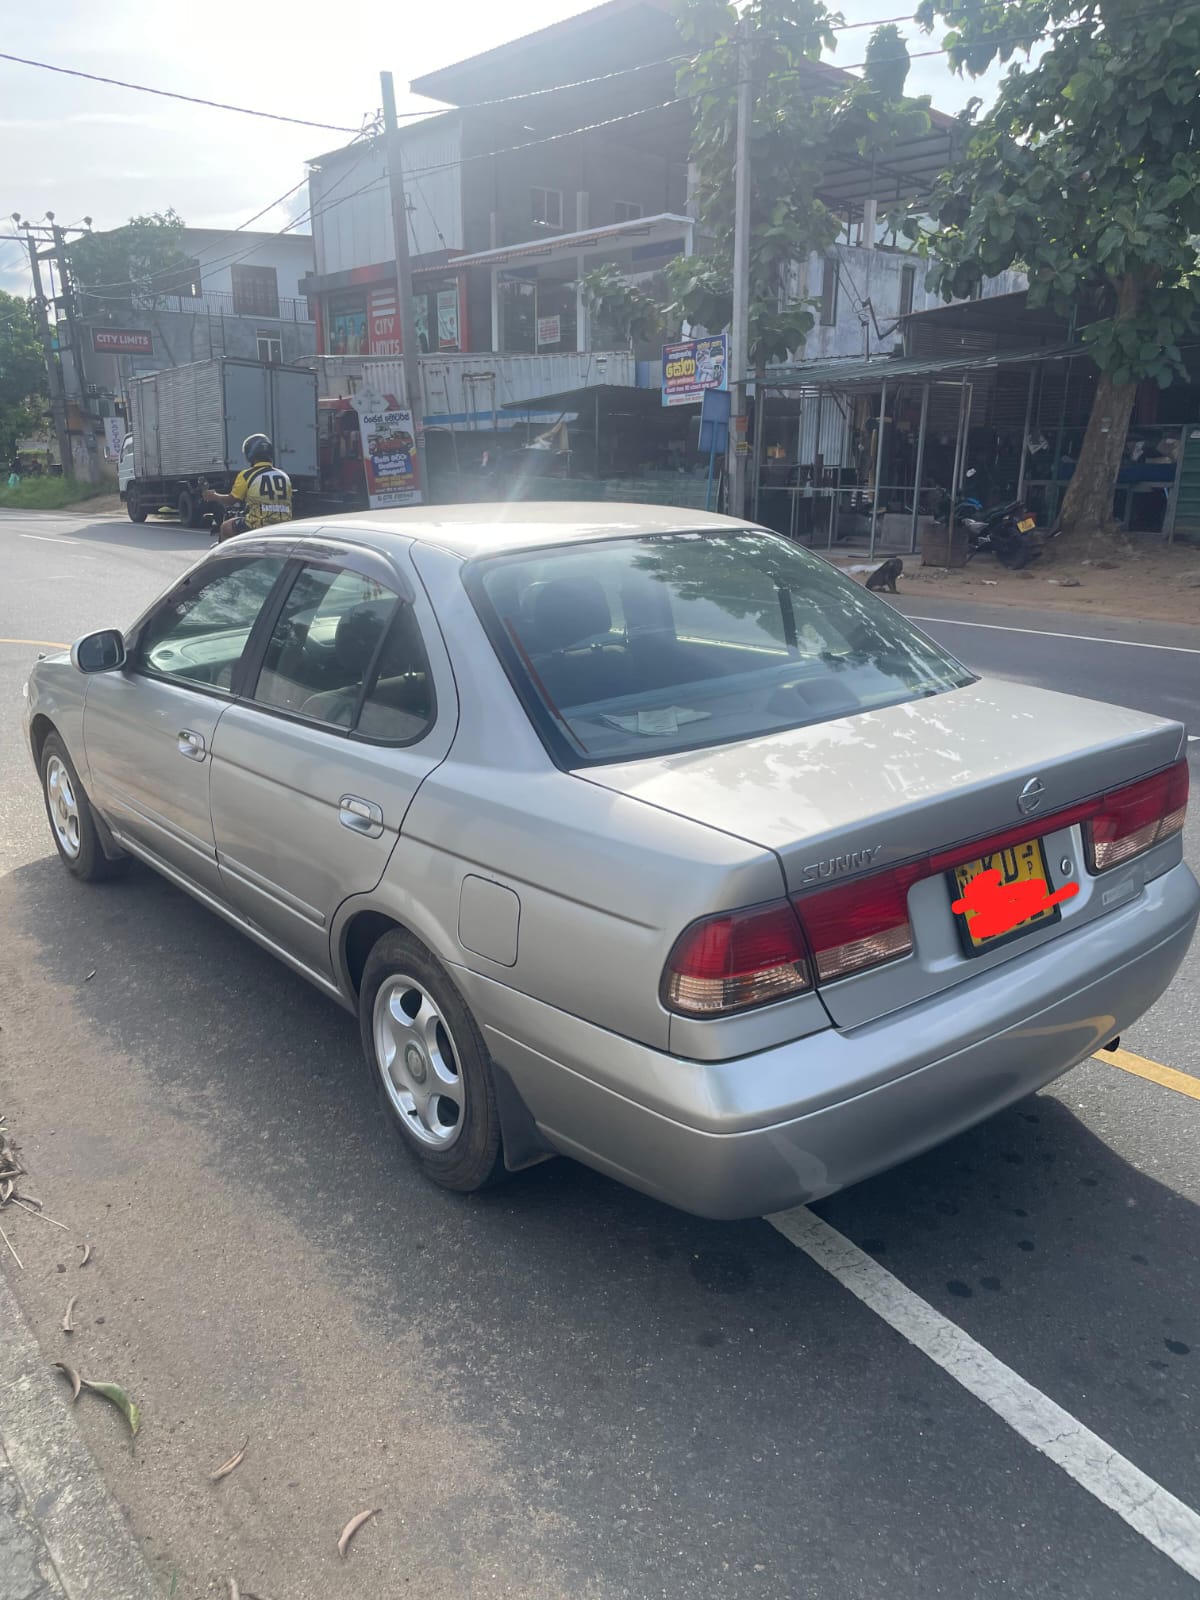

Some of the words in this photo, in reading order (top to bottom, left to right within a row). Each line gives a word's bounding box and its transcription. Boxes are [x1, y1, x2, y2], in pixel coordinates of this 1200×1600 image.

[375, 317, 394, 336] CITY
[96, 334, 118, 344] CITY
[119, 335, 149, 345] LIMITS
[371, 338, 401, 356] LIMITS
[260, 475, 287, 500] 49
[801, 844, 882, 884] SUNNY
